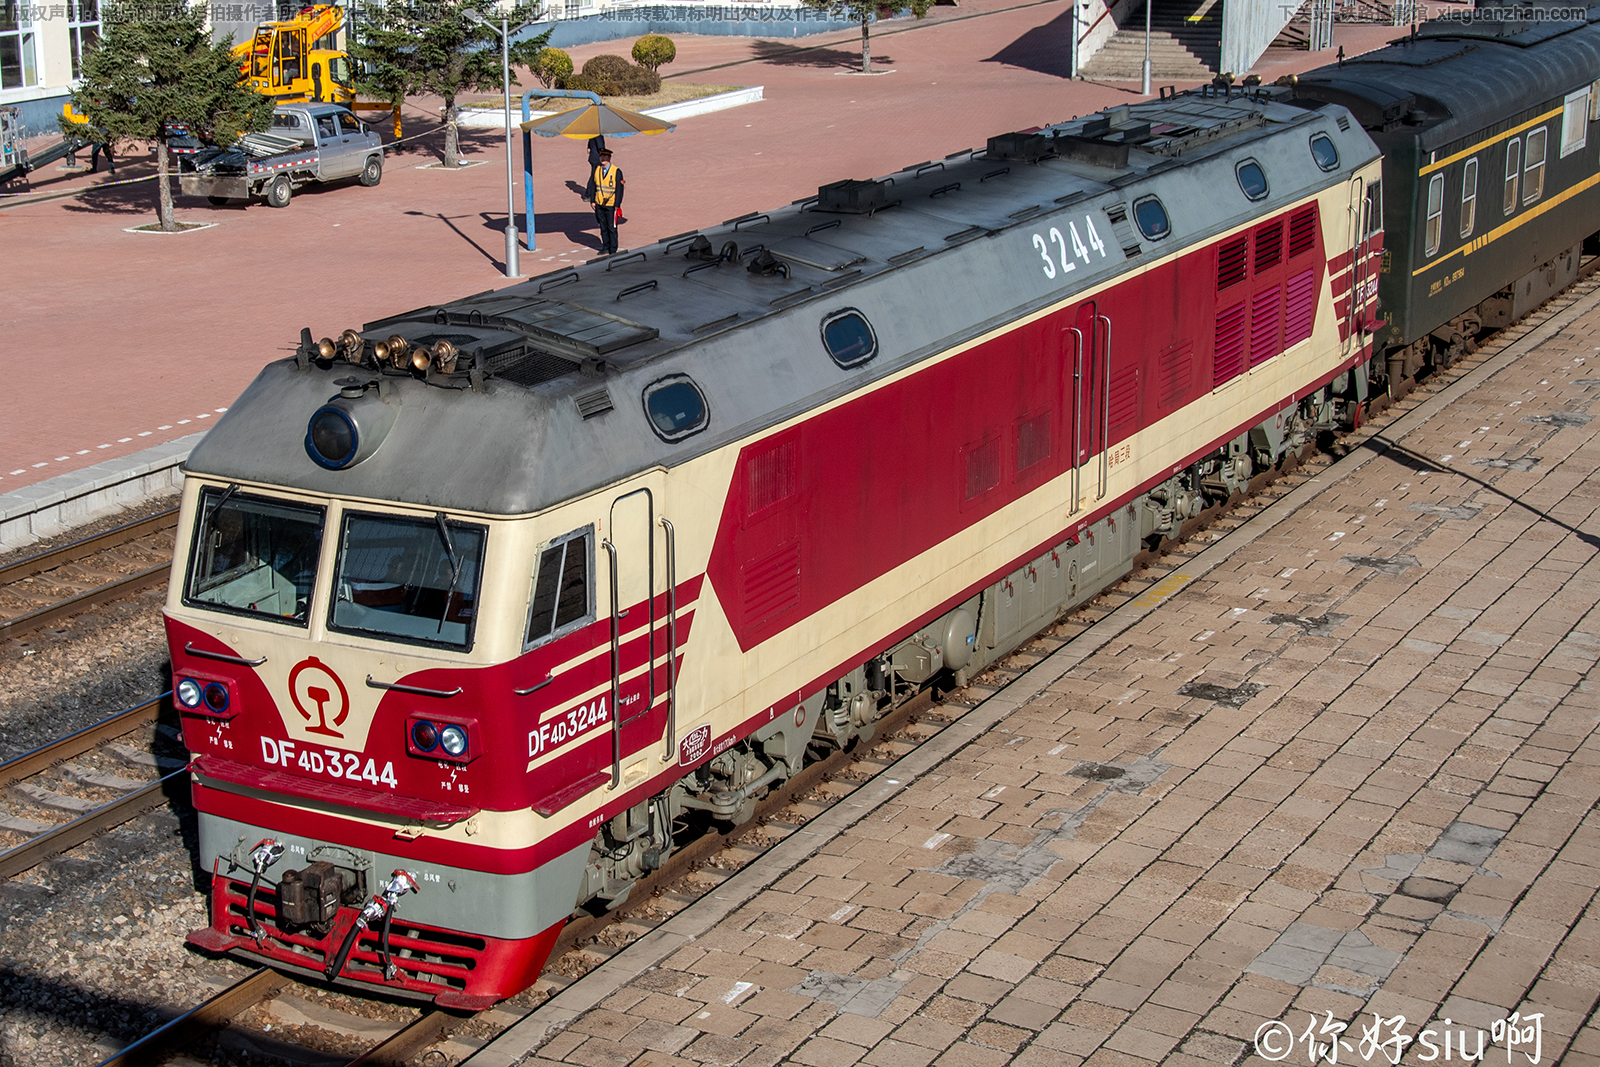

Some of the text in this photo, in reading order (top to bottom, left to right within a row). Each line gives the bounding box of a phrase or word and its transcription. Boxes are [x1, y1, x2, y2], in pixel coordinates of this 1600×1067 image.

[1032, 215, 1107, 280] 3244
[528, 696, 608, 757] DF4D3244
[260, 735, 398, 788] DF4D3244
